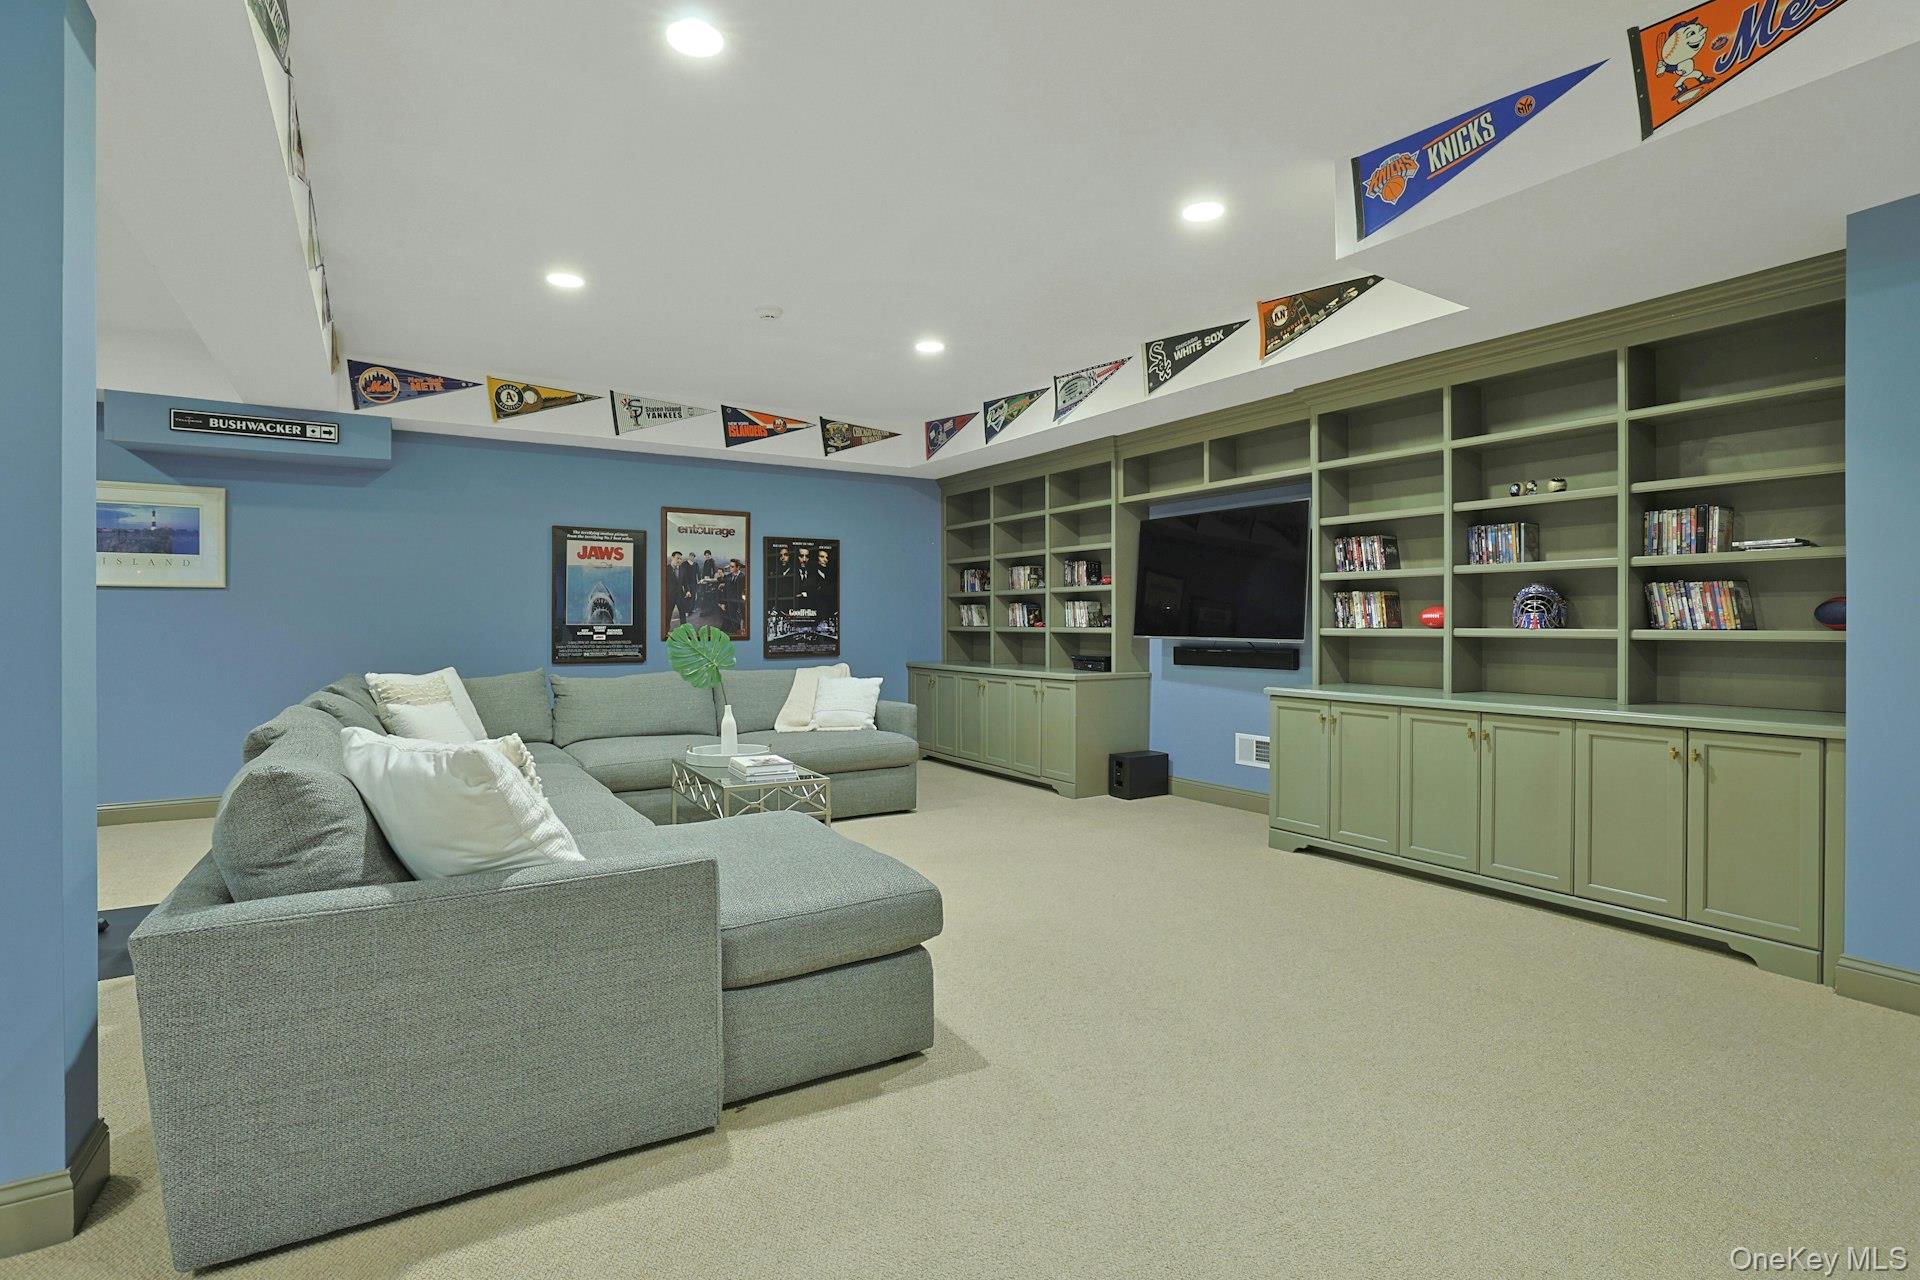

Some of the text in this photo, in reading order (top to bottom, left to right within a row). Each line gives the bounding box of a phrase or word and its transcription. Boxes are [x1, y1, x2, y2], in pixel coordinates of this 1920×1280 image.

[1427, 111, 1496, 173] KNICKS
[1368, 153, 1417, 197] KNICKS
[1173, 329, 1225, 361] WHITE SOX
[410, 382, 444, 392] METS
[646, 411, 683, 419] YANKEES
[209, 417, 302, 435] BUSHWACKER
[728, 425, 768, 437] ISLANDERS
[677, 524, 736, 538] entourage
[577, 545, 624, 561] JAWS
[102, 557, 191, 568] ISLAND
